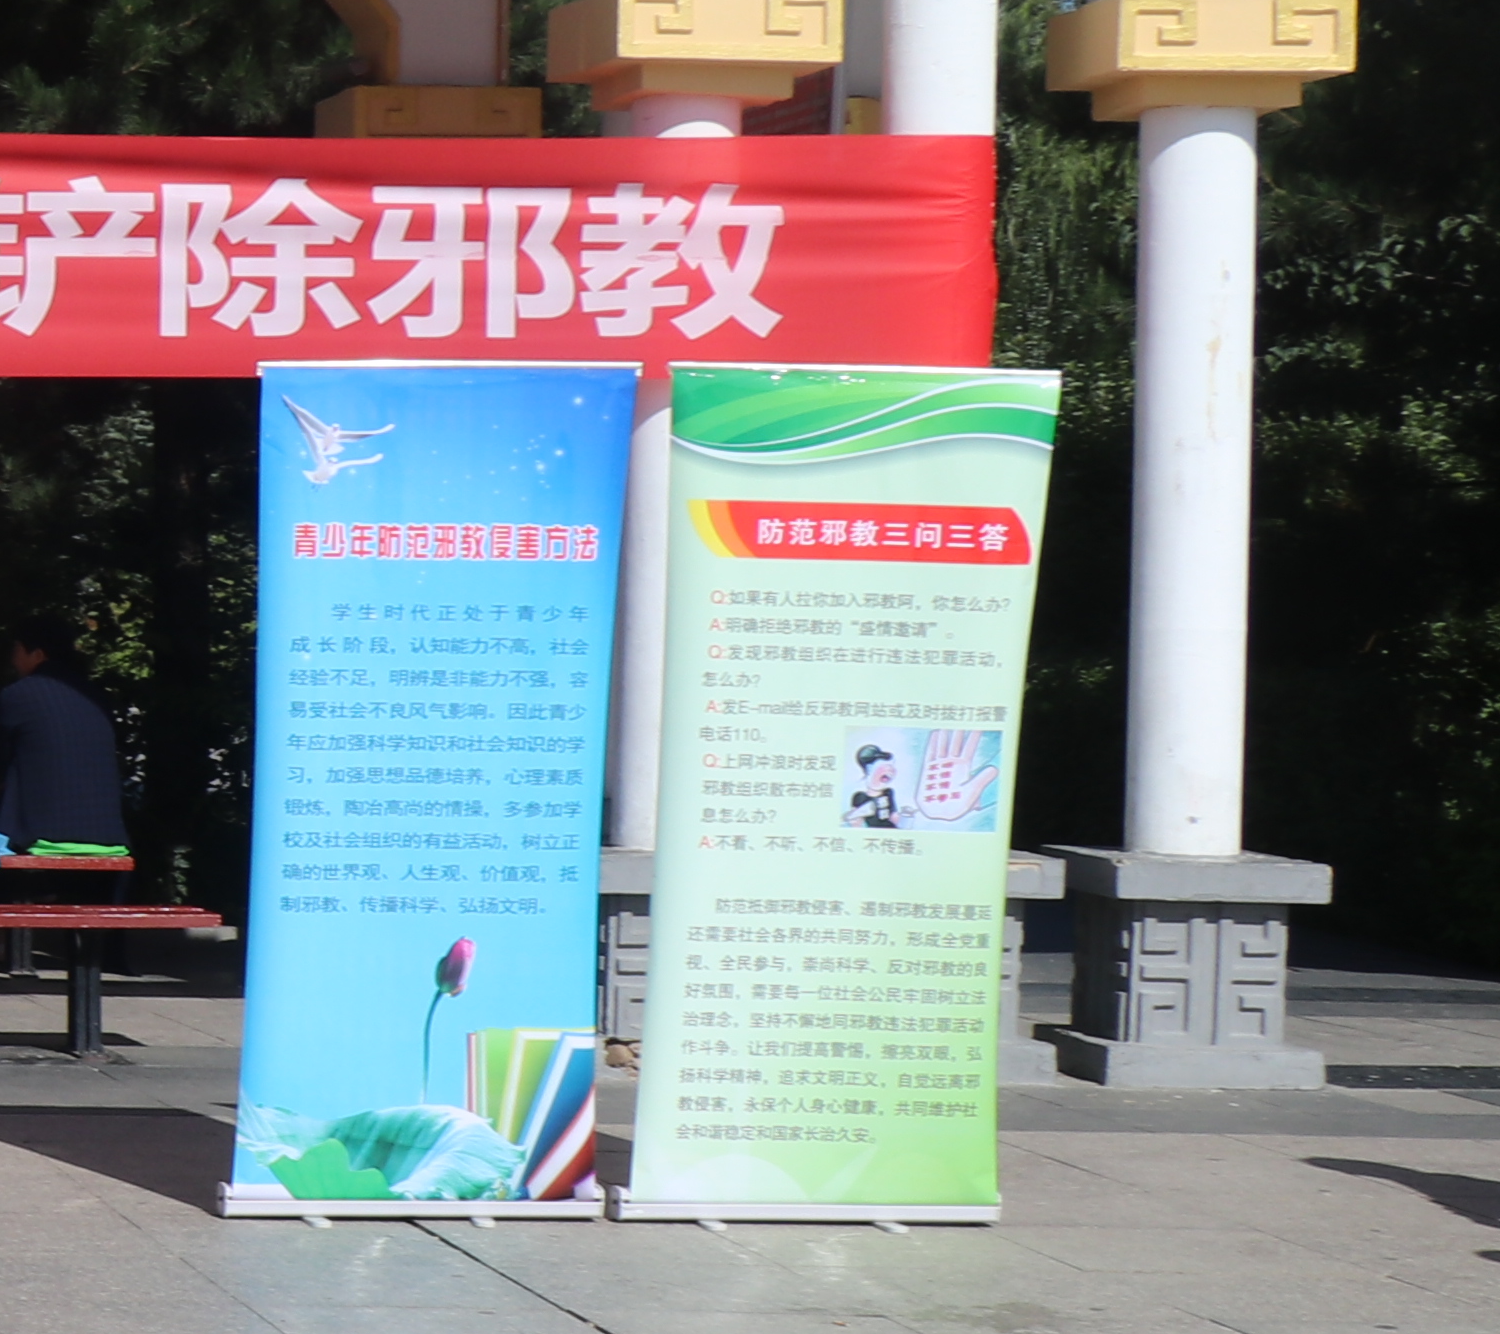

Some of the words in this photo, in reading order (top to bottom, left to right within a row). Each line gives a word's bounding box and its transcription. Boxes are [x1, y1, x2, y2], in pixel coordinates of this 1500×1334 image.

[294, 523, 598, 560] 青少年防范邪教侵害方法
[756, 518, 1010, 551] 防范邪教三问三答
[331, 603, 589, 622] 学生时代正处于青少年
